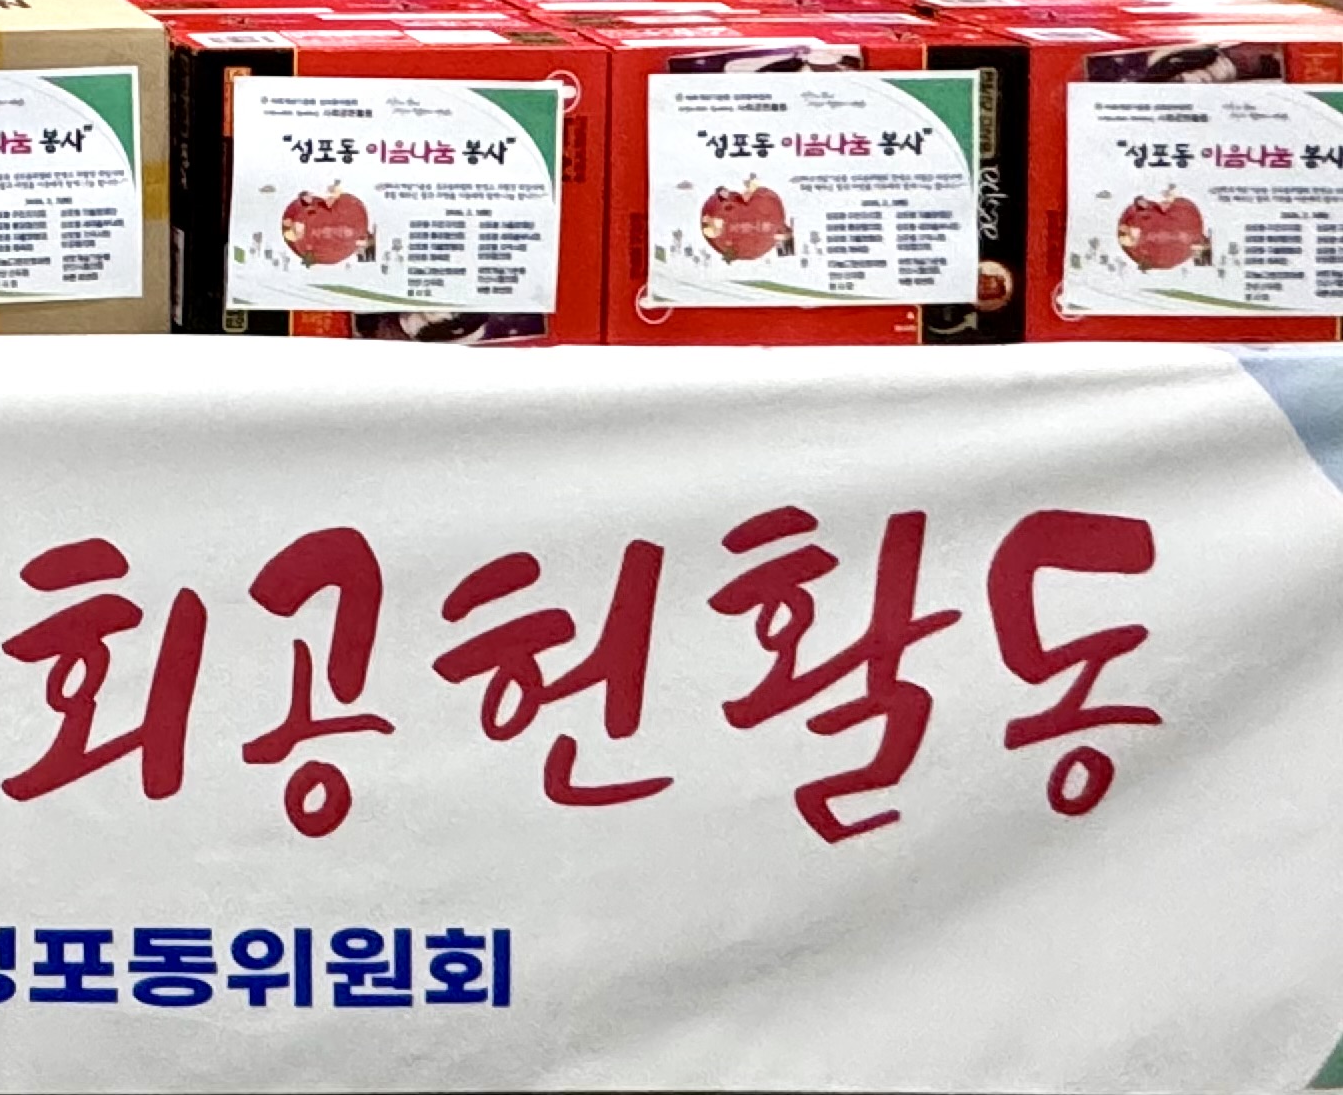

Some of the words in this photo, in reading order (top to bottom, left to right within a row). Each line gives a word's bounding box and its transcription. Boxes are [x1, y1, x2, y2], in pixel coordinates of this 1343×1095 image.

[366, 140, 456, 164] 이음나눔
[782, 133, 871, 156] 이음나눔
[1201, 144, 1294, 168] 이음나눔
